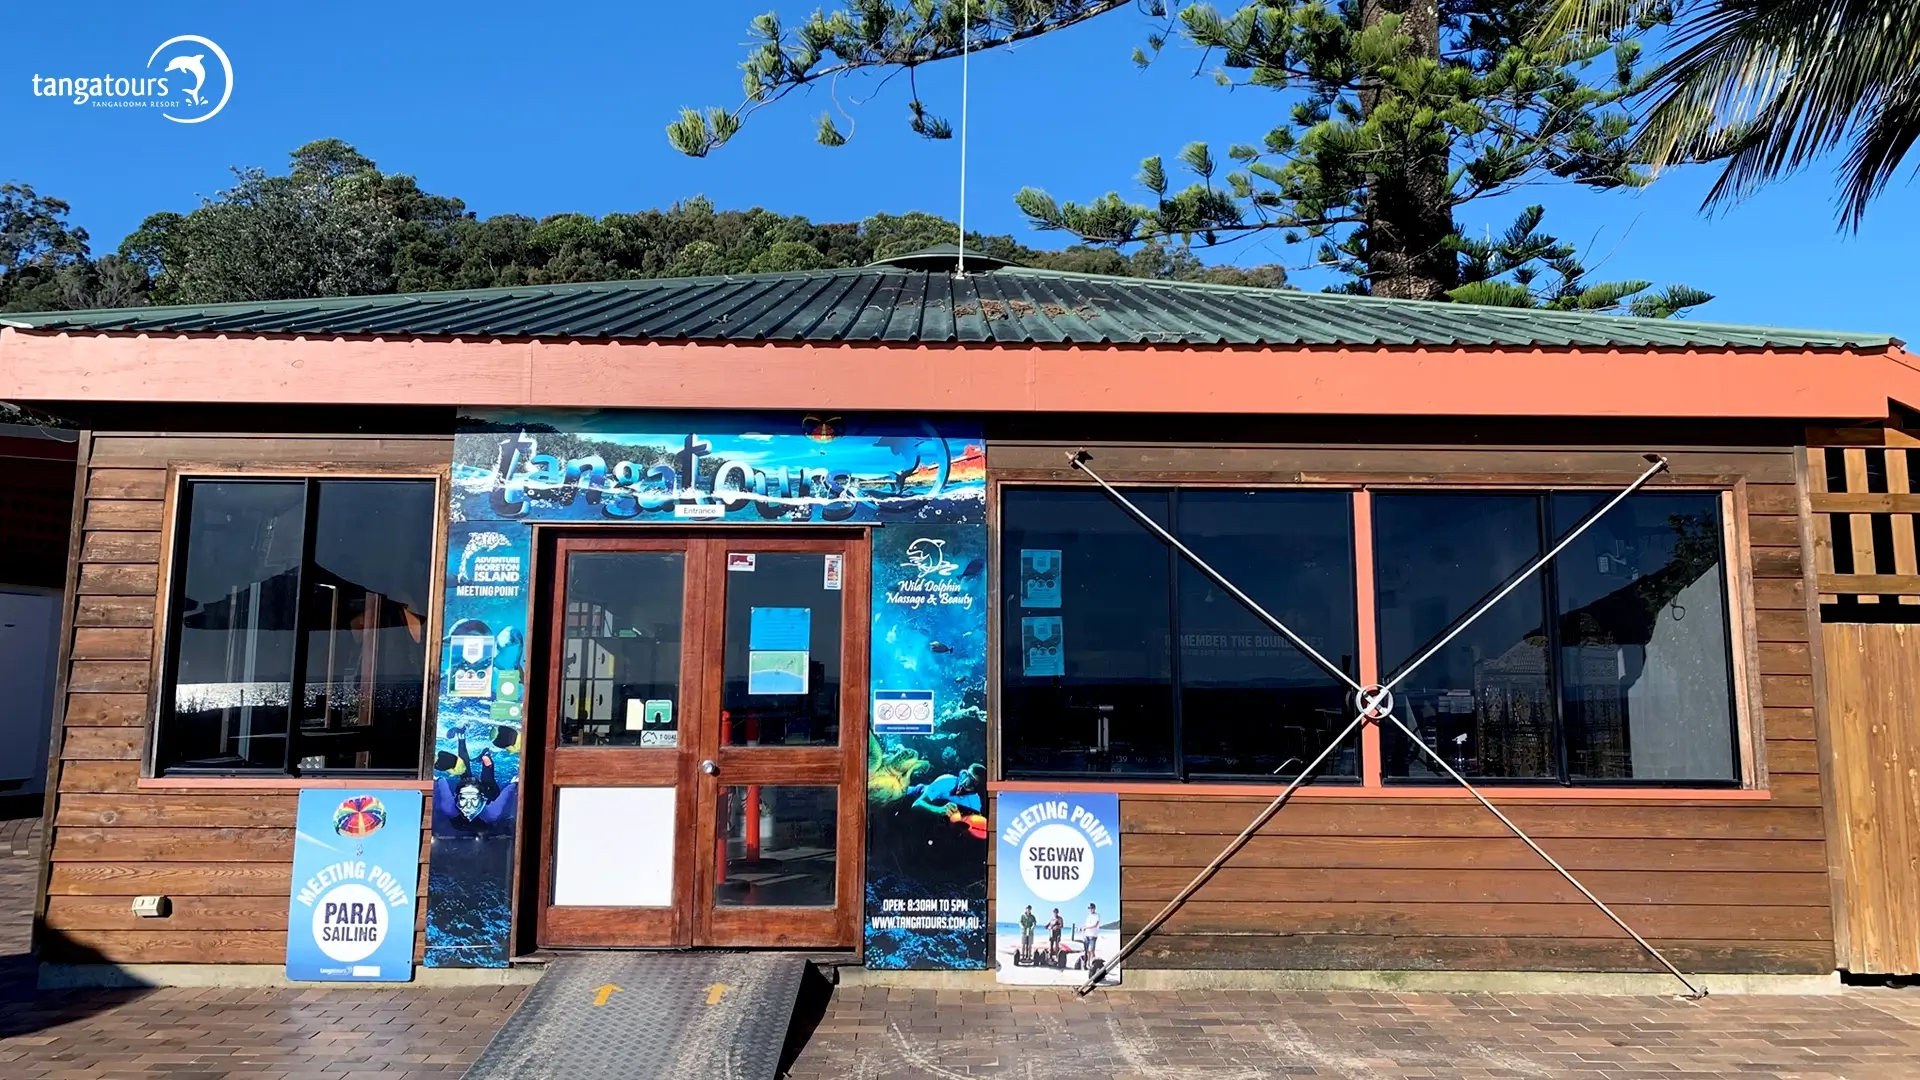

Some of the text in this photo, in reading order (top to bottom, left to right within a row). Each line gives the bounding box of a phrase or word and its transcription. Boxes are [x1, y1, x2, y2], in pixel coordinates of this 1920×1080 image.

[683, 507, 717, 515] Entrance
[474, 556, 520, 564] ADVENTURE
[474, 563, 520, 572] MORETON
[473, 571, 520, 582] ISLAND
[456, 585, 519, 597] MEETING POINT
[897, 579, 961, 598] Wild Dolphin
[886, 592, 973, 610] Massage & Beauty
[1002, 800, 1113, 849] MEETING POINT
[1029, 846, 1085, 863] SEGWAY
[1033, 865, 1080, 881] TOURS
[296, 860, 409, 908] MEETING POINT
[882, 899, 969, 911] OPEN: 8:30AM TO 5PM
[324, 902, 378, 925] PARA
[871, 916, 980, 929] WWW.TANGATOURS.COM.AU
[322, 926, 378, 942] SAILING
